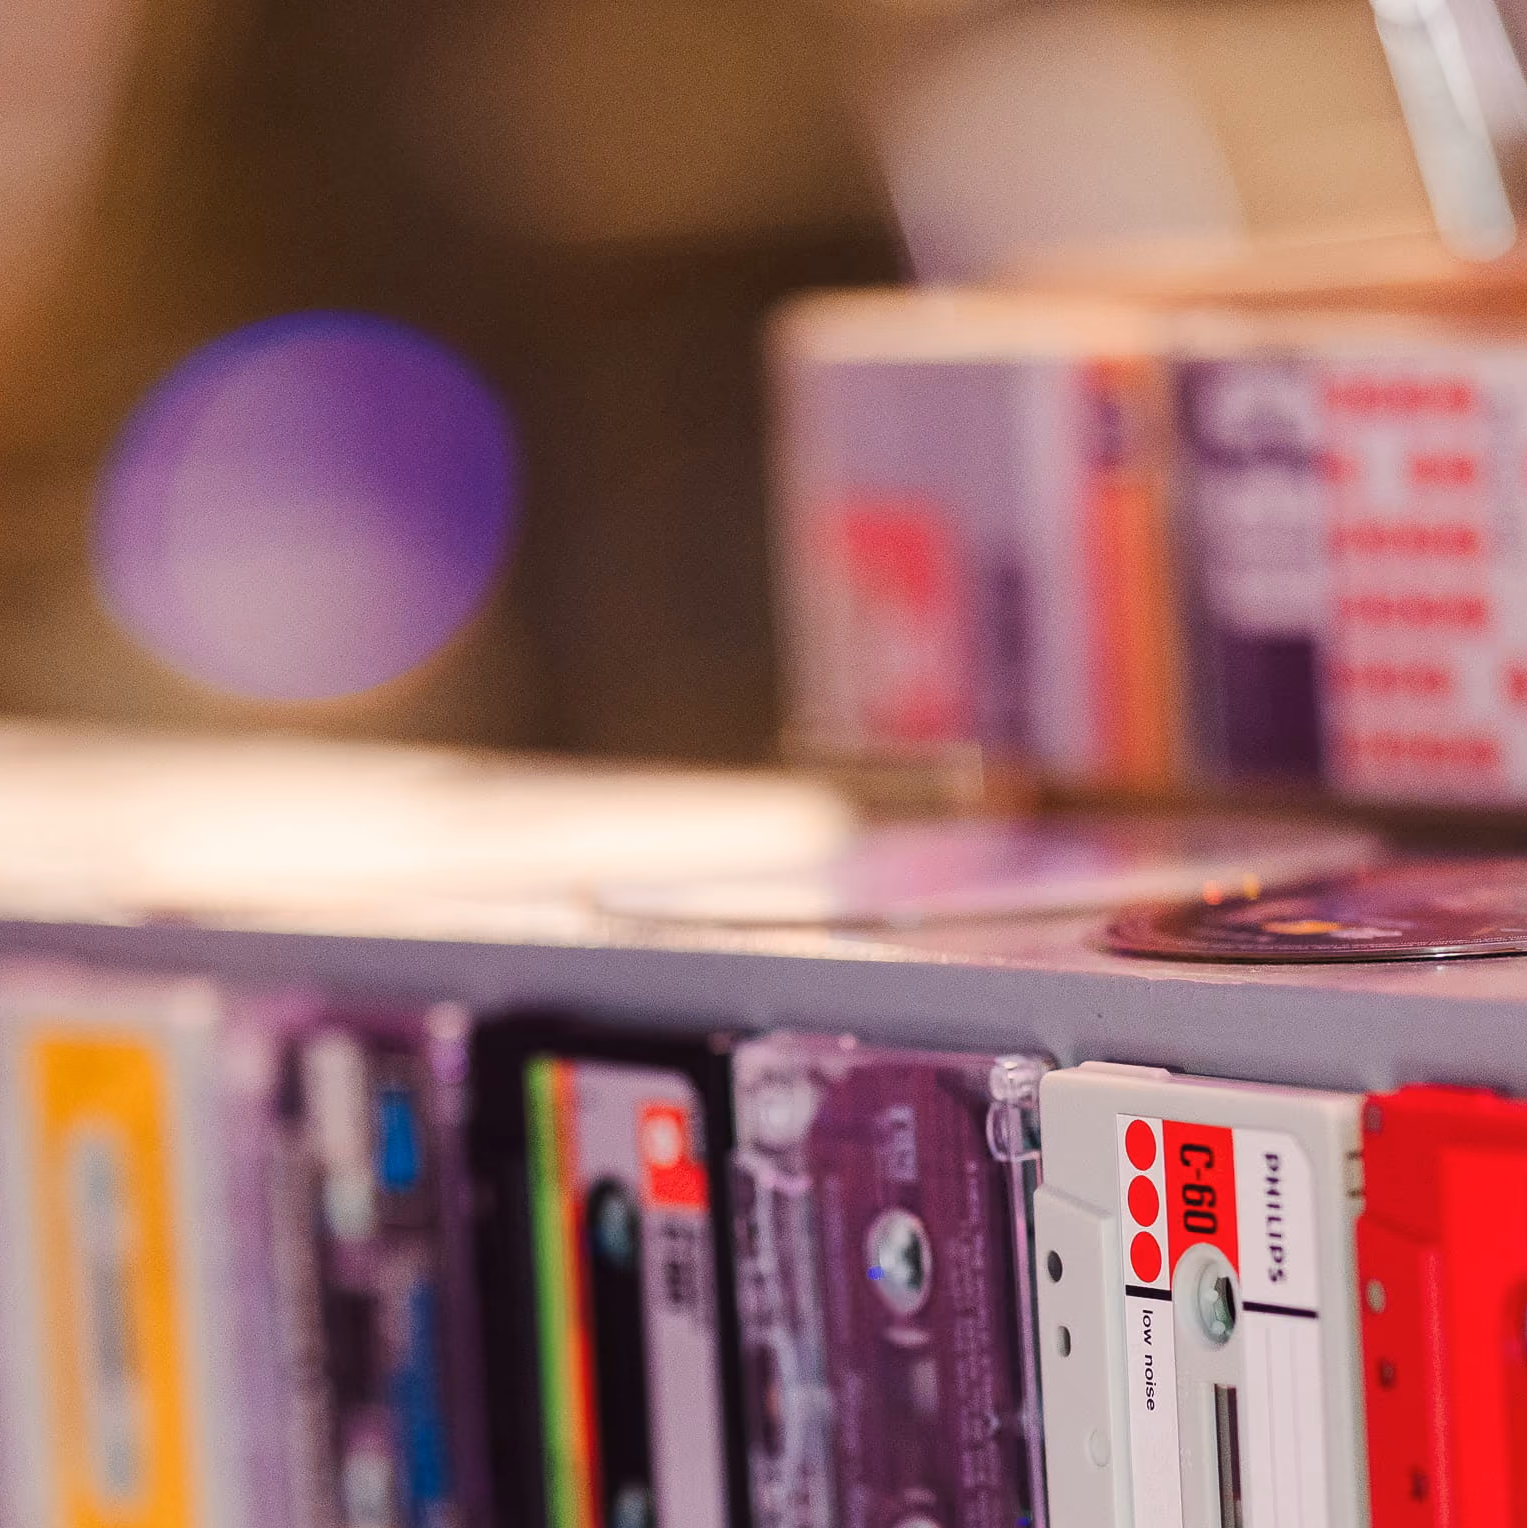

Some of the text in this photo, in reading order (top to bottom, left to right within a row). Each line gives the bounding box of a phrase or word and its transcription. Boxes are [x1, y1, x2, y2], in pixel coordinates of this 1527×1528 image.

[1179, 1142, 1218, 1236] C-60
[1264, 1150, 1287, 1283] PHILIPS
[1141, 1308, 1156, 1412] low noise
